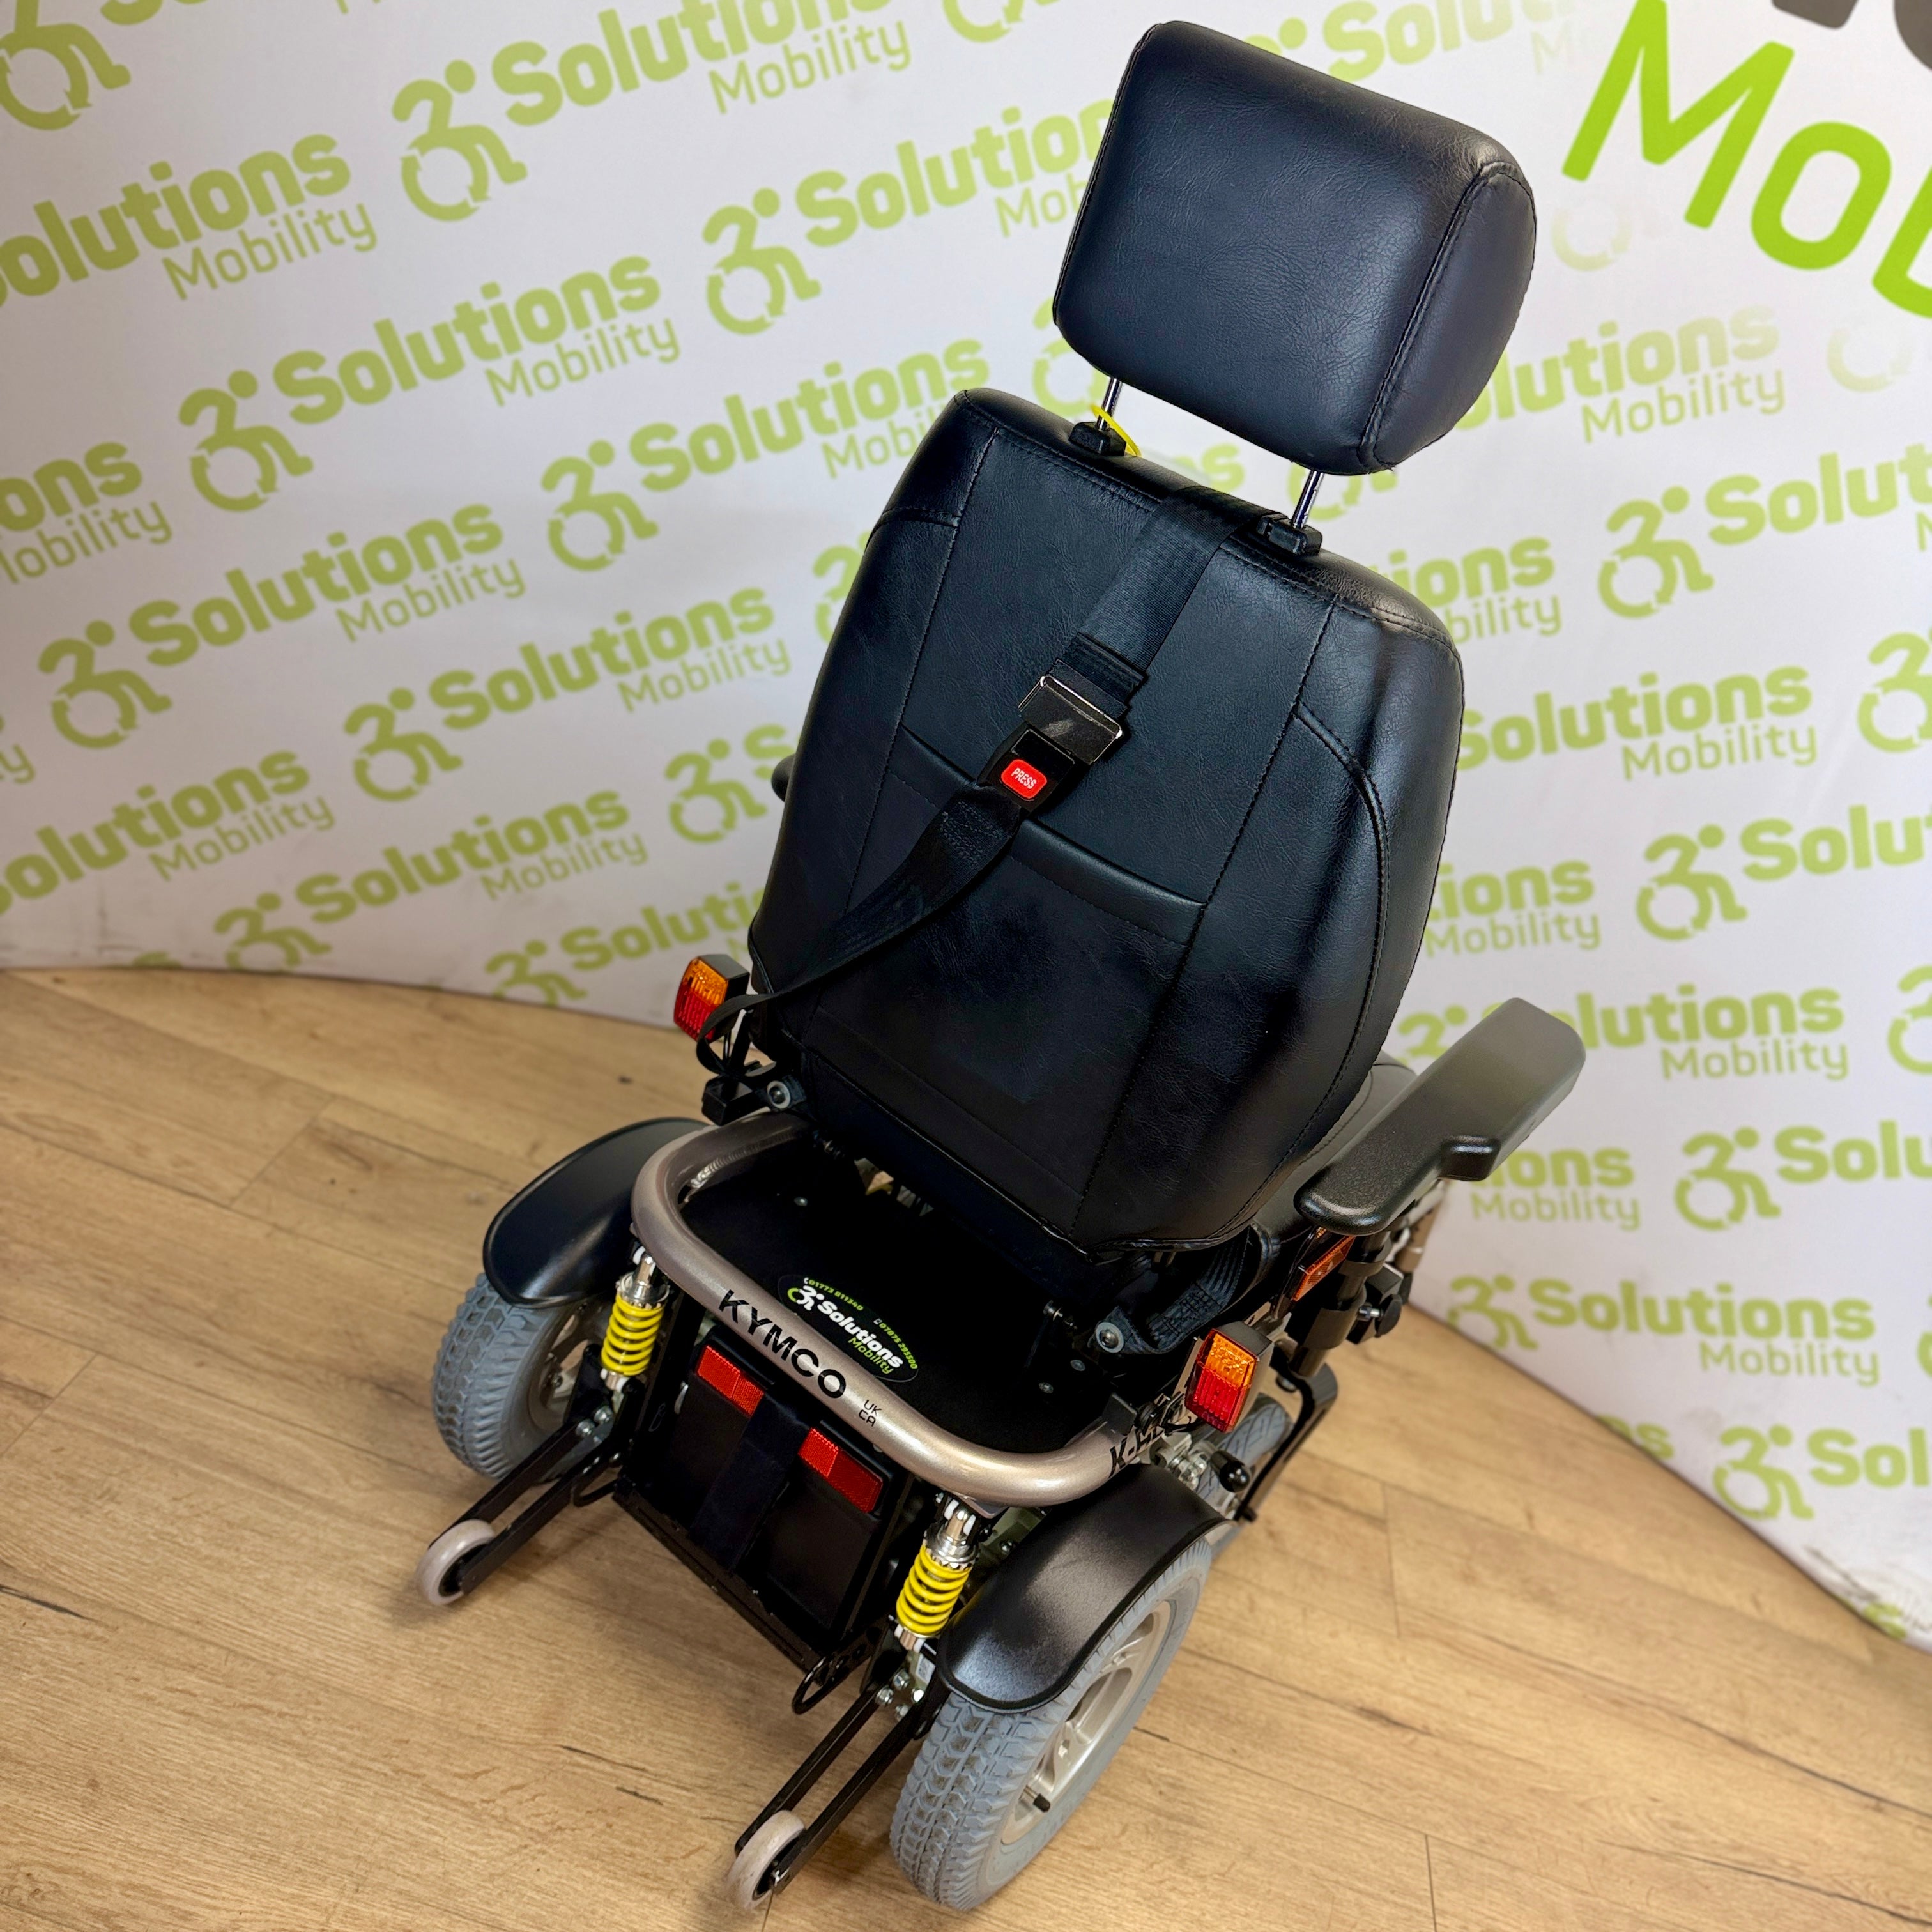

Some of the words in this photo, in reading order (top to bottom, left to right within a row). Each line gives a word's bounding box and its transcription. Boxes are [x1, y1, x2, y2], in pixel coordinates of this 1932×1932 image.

[492, 0, 891, 126] Solutio
[709, 20, 912, 114] Mobility
[0, 134, 351, 309] olutions
[161, 203, 378, 300] Mobility
[272, 256, 661, 424] Solutions
[485, 318, 680, 407] Mobility
[629, 339, 990, 492] Solutions
[1582, 369, 1785, 443] Mobility
[129, 505, 502, 666] Solutions
[334, 560, 526, 642] Mobility
[1370, 537, 1555, 608] ions
[1446, 595, 1563, 644] bility
[429, 588, 774, 730] Solutions
[618, 636, 792, 713] Mobility
[1011, 767, 1037, 789] PRESS
[1622, 725, 1818, 781] Mobility
[0, 751, 310, 915] olutions
[148, 797, 336, 881] Mobility
[295, 790, 629, 924] Solutions
[480, 831, 648, 901] Mobility
[1739, 804, 1932, 881] Solu
[1427, 859, 1595, 921] ions
[1423, 911, 1602, 958] Mobility
[1481, 984, 1844, 1052] lutions
[1662, 1039, 1849, 1081] Mobility
[1471, 1192, 1641, 1232] Mobility
[717, 1289, 847, 1399] KYMCO
[817, 1301, 903, 1368] Solutions
[1528, 1277, 1876, 1341] Solutions
[848, 1337, 894, 1374] Mobility
[1699, 1342, 1882, 1388] Mobility
[858, 1409, 876, 1427] CA
[864, 1399, 882, 1416] UK
